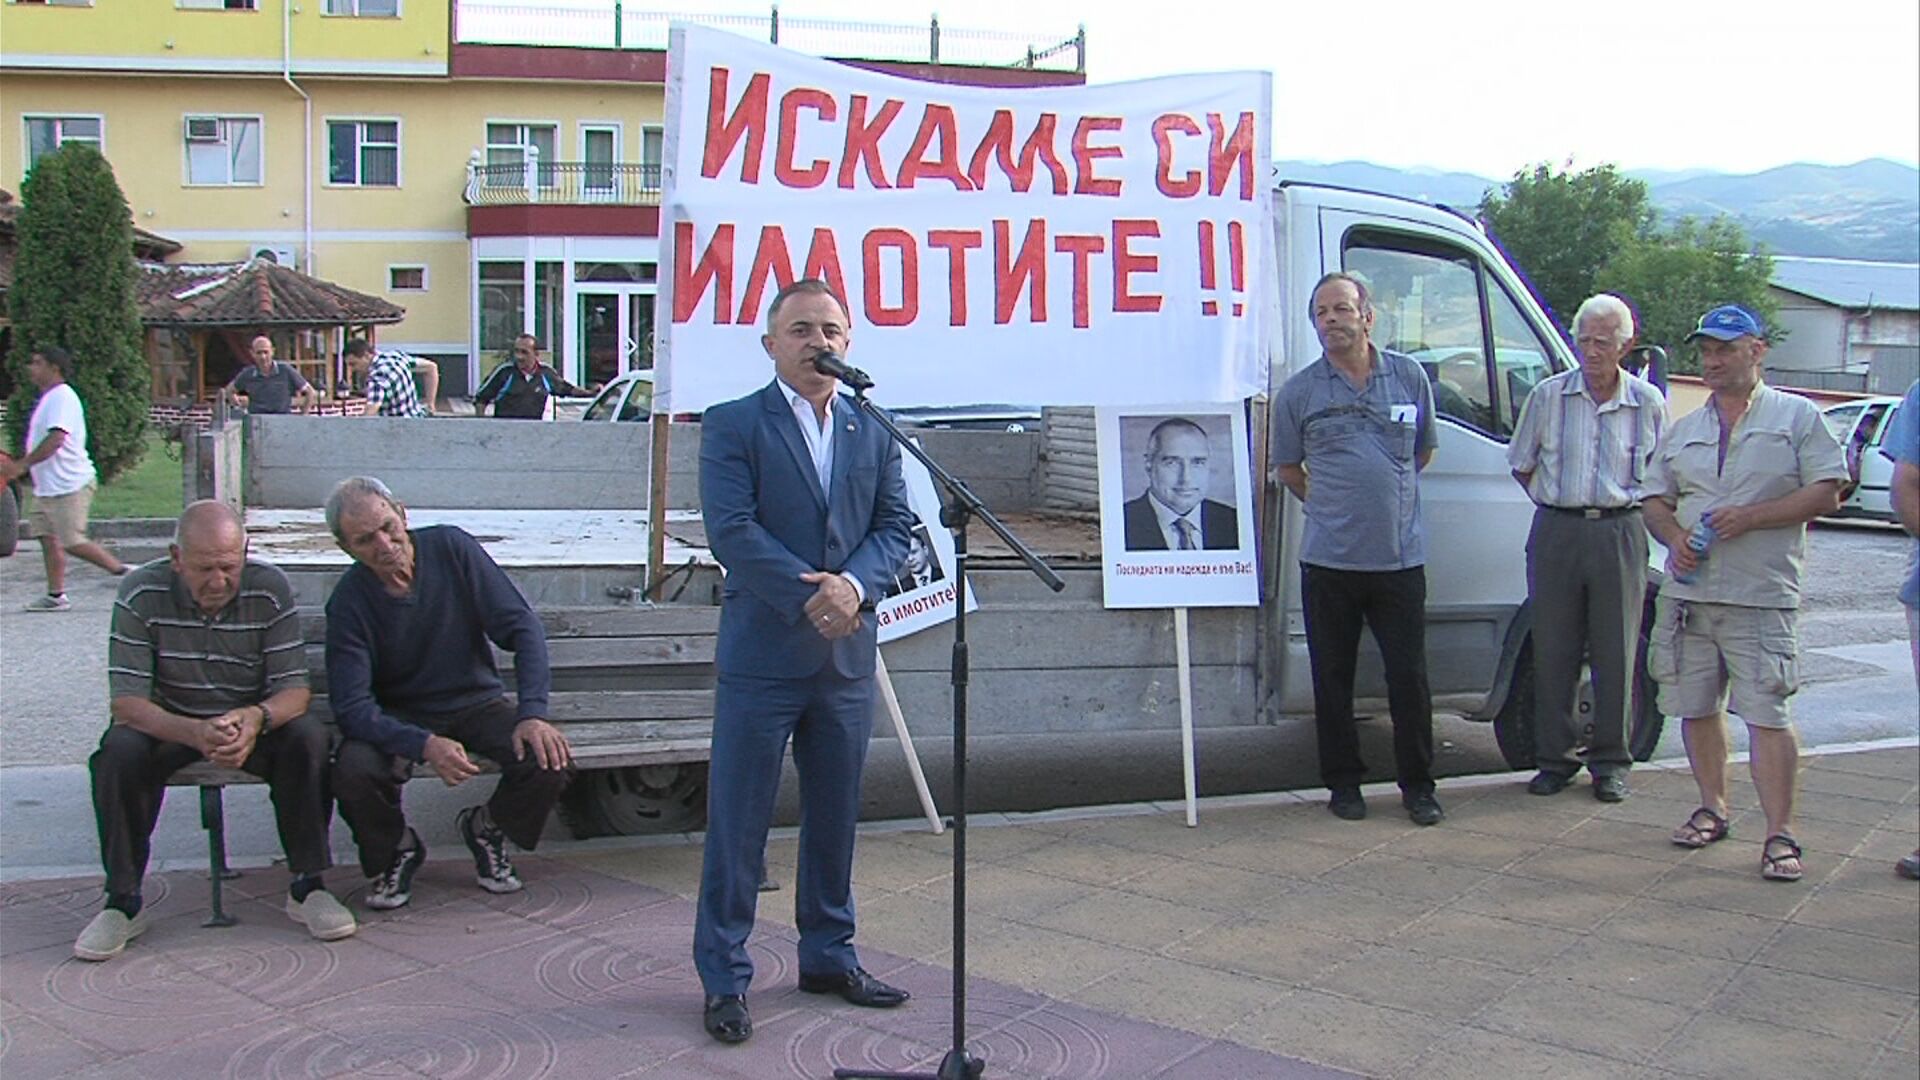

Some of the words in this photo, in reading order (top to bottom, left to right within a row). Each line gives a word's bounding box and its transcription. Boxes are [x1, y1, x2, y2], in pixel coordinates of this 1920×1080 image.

[701, 66, 1123, 198] ИСКАМЕ
[1152, 111, 1255, 201] СИ
[672, 219, 1163, 329] ИМОТИТЕ
[1115, 563, 1163, 577] Последната
[1176, 565, 1211, 577] надежда
